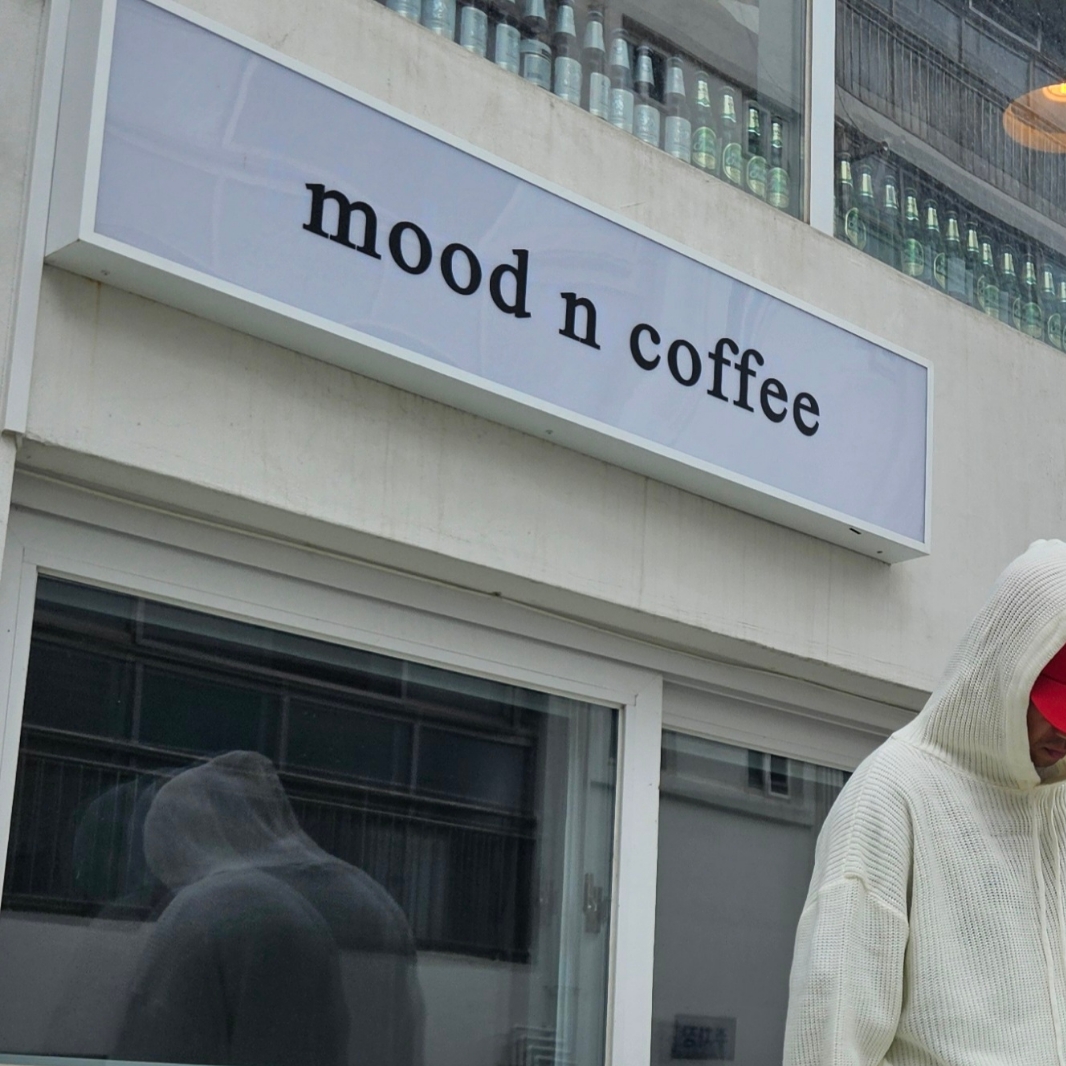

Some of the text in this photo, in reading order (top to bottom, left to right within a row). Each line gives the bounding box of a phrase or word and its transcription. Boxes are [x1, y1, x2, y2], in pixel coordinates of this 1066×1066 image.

[302, 182, 821, 437] mood n coffee
